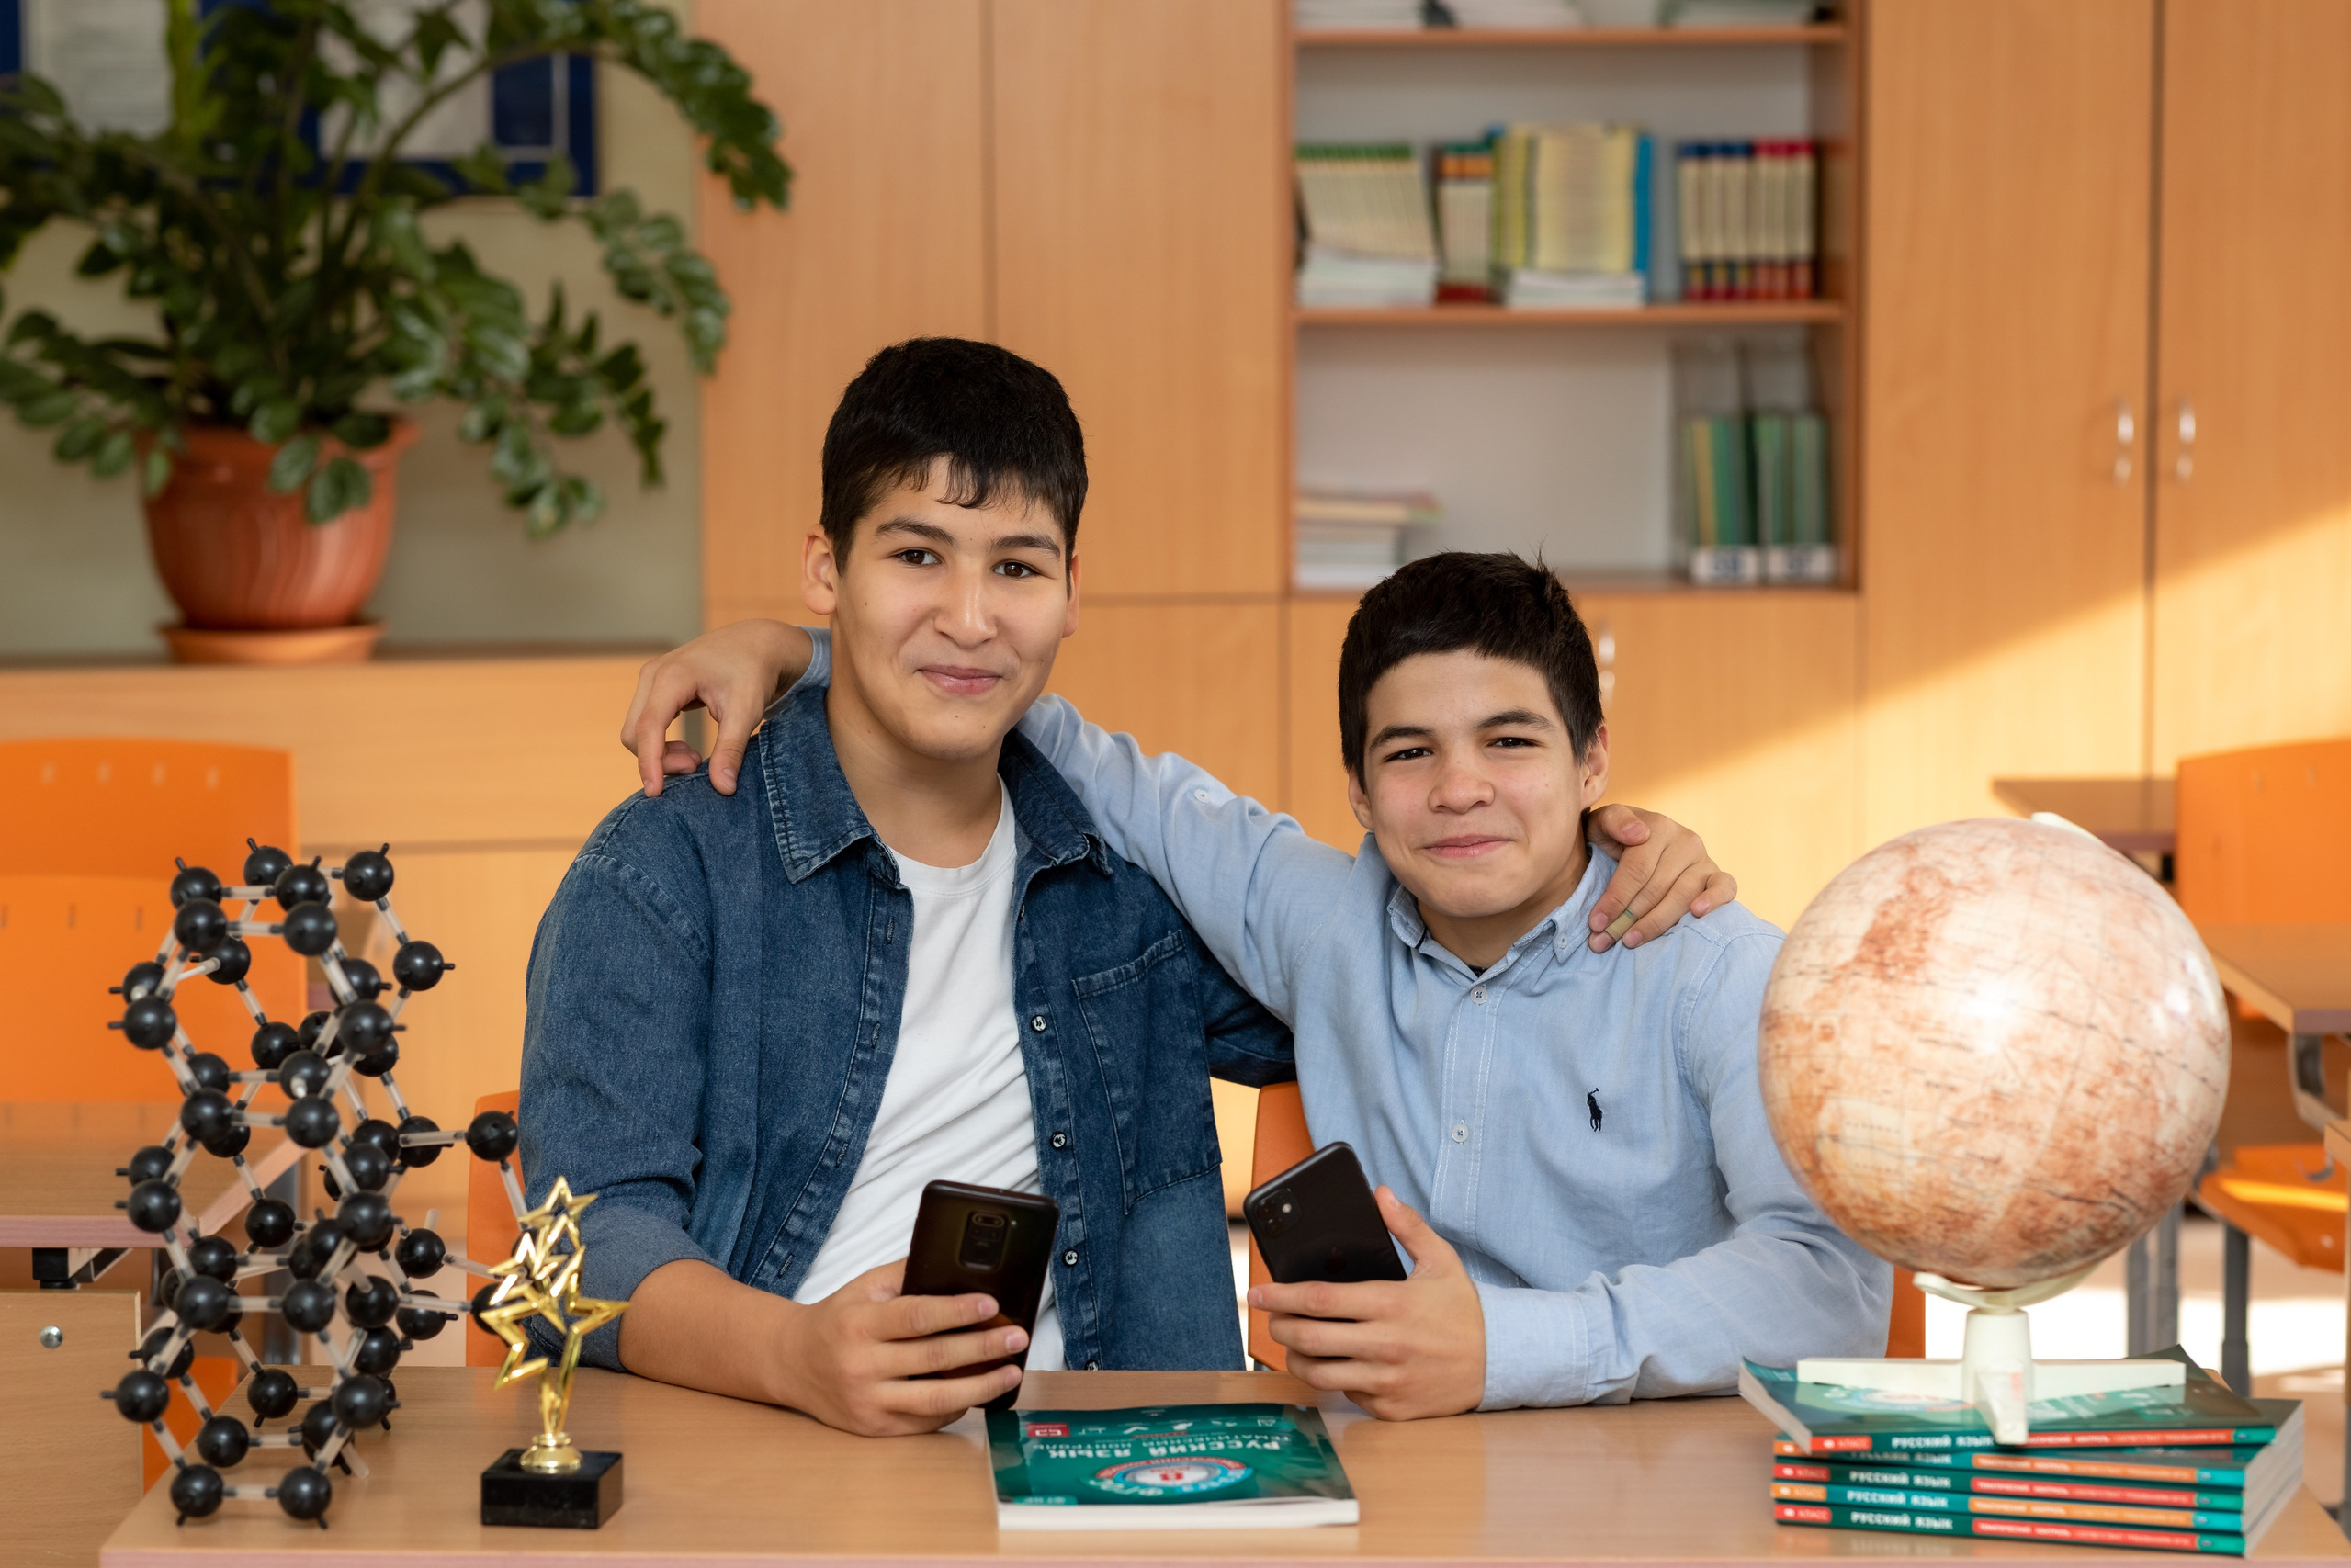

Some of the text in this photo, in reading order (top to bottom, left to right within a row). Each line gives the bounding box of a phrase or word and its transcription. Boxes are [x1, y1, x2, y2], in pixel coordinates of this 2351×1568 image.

[1147, 1439, 1280, 1457] РУССКИЙ
[1892, 1435, 1951, 1449] РУССКИЙ
[1048, 1449, 1131, 1459] ЯЗЫК
[1849, 1470, 1909, 1485] РУССКИЙ
[1914, 1475, 1951, 1488] ЯЗЫК
[1847, 1490, 1906, 1506] РУССКИЙ
[1911, 1495, 1948, 1507] ЯЗЫК
[1850, 1511, 1911, 1527] РУССКИЙ
[1915, 1517, 1952, 1529] ЯЗЫК
